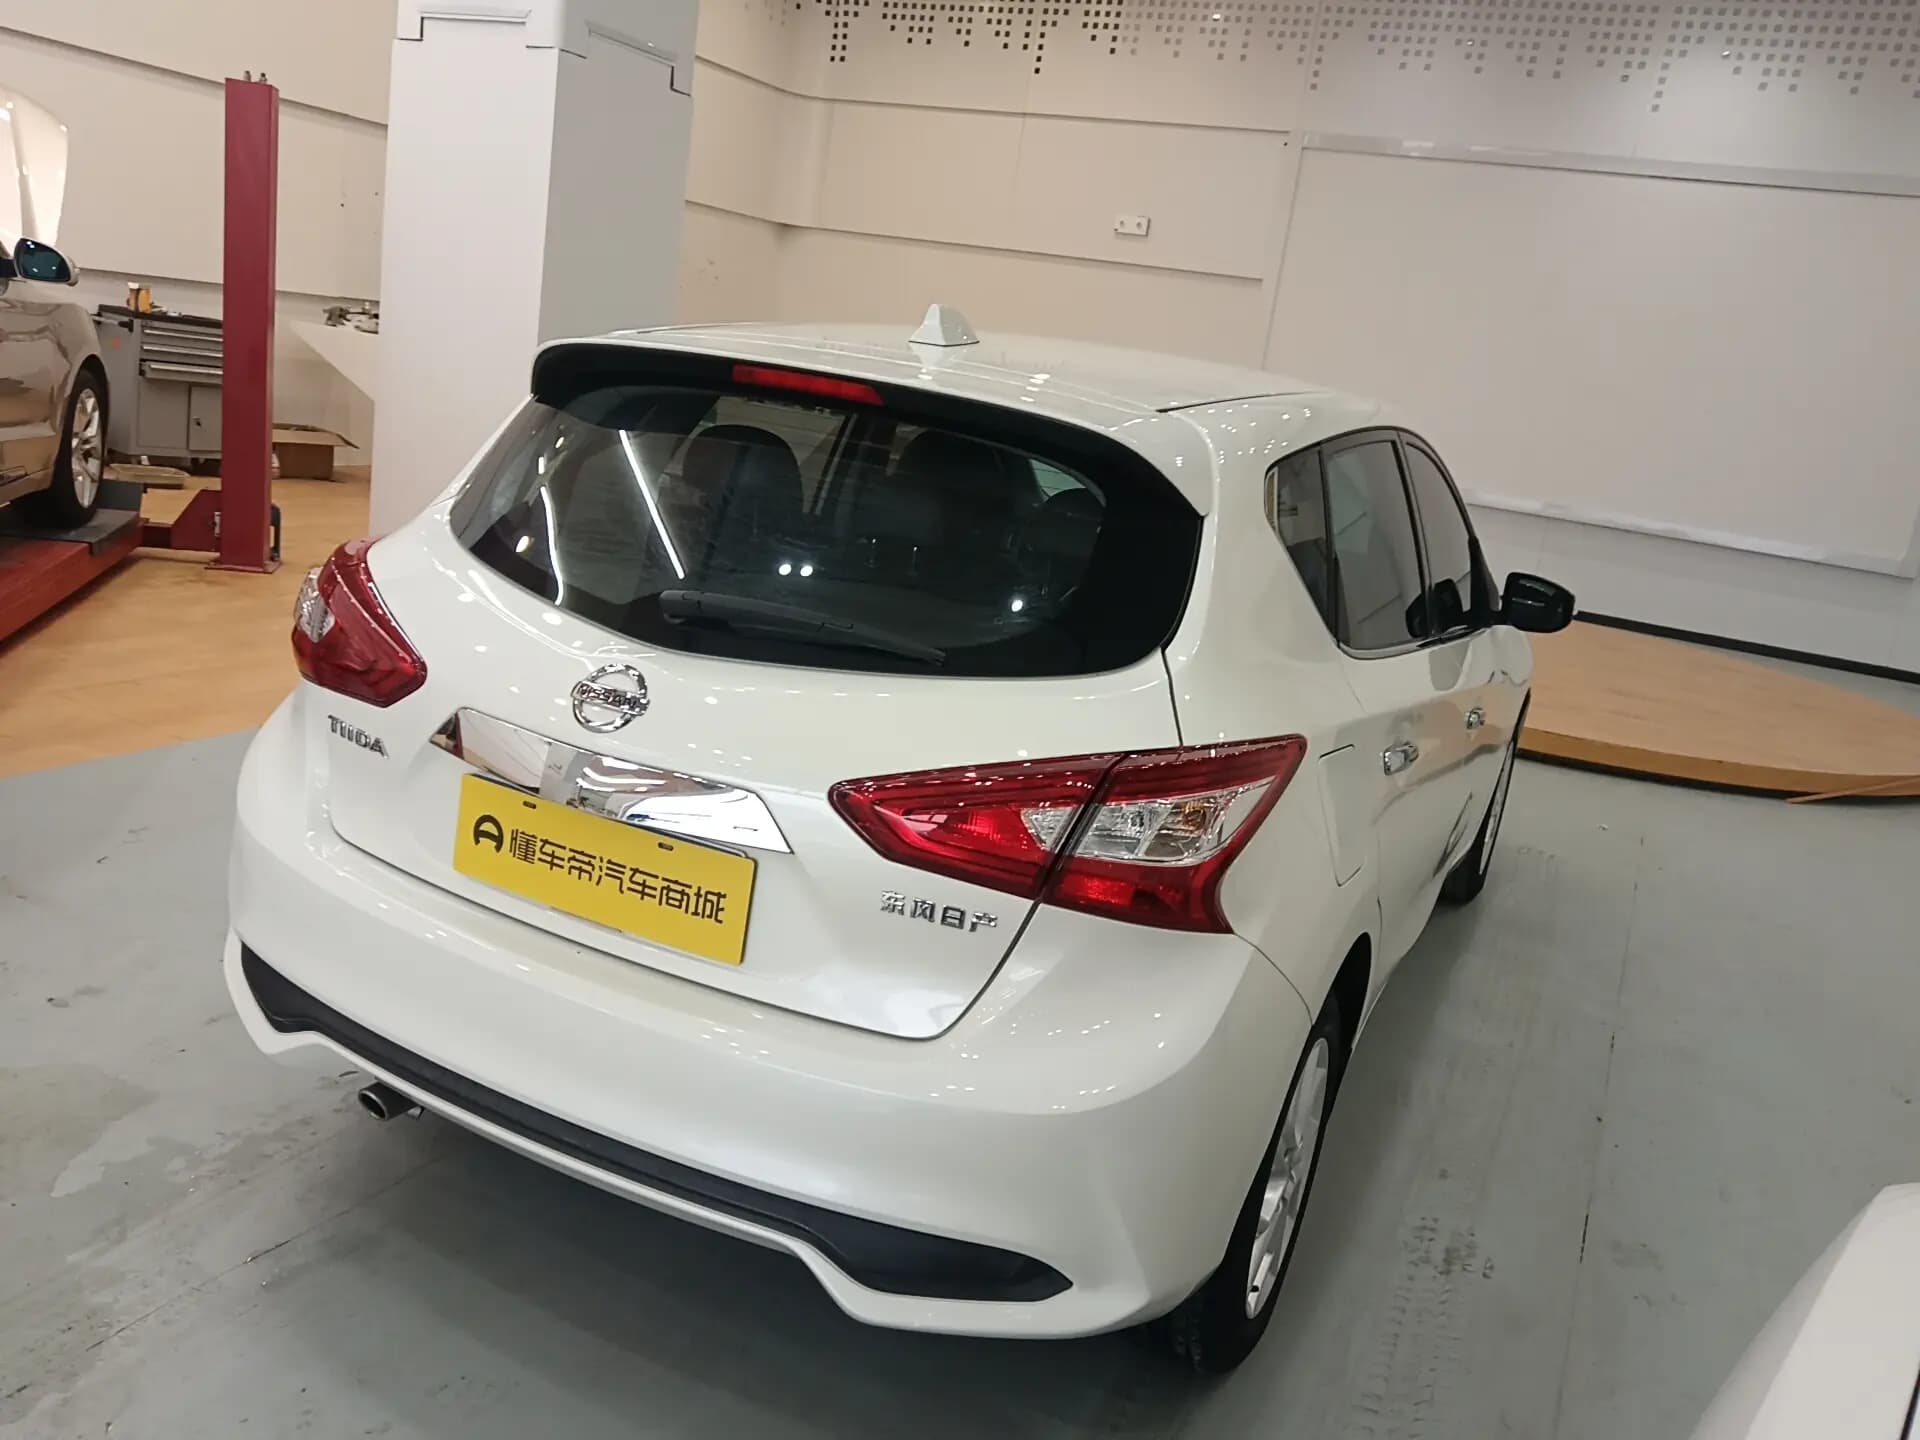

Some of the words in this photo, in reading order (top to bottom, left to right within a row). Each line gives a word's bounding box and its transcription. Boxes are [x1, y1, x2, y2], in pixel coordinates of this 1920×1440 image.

[328, 715, 389, 758] TIIDA
[508, 828, 727, 924] 懂车帝汽车商城
[880, 889, 998, 932] 东风日产
